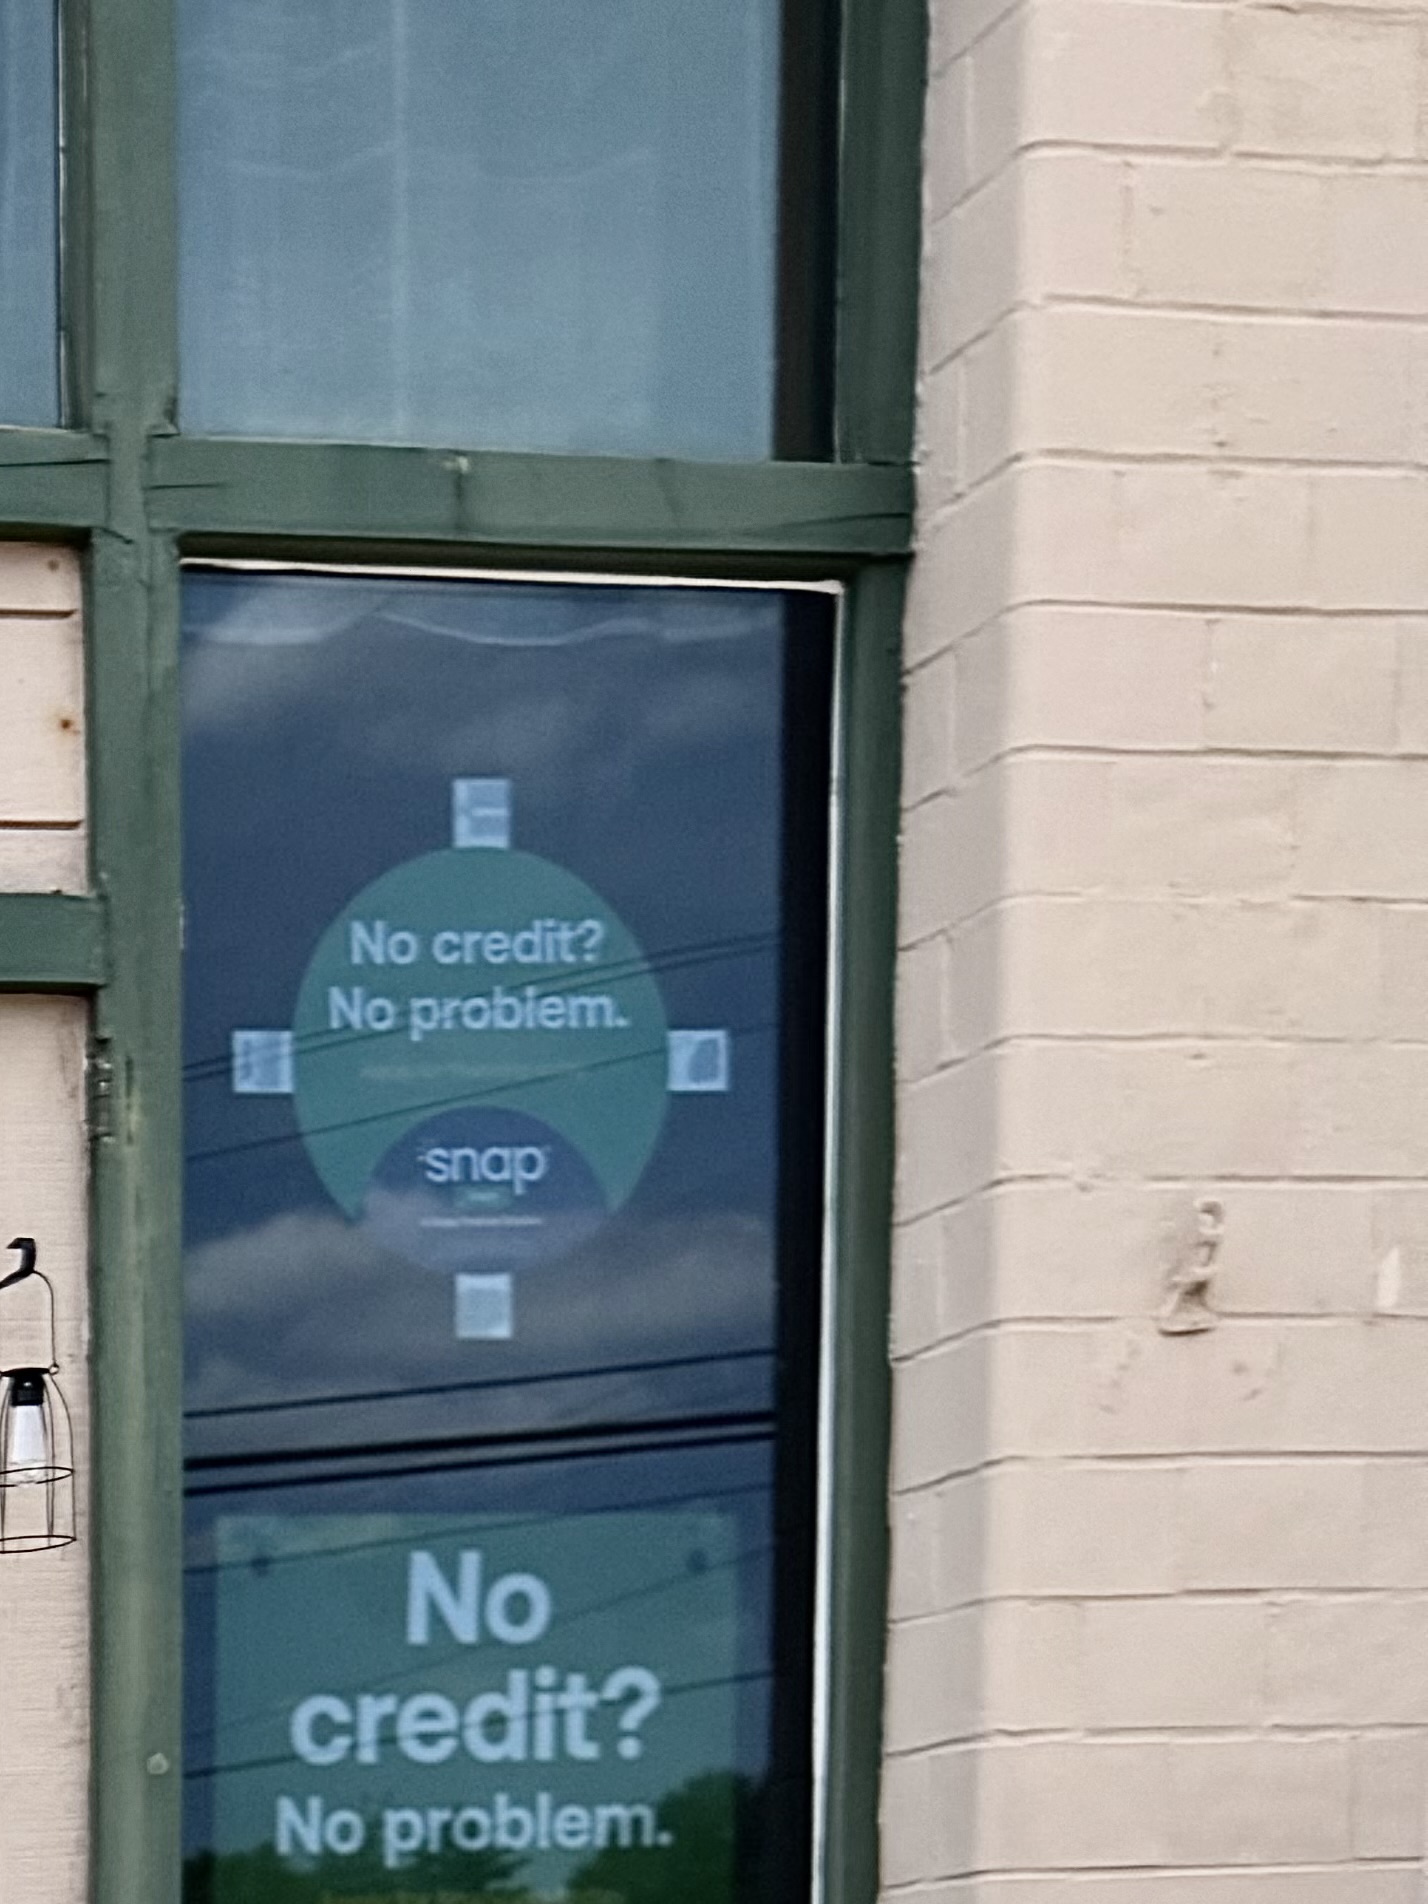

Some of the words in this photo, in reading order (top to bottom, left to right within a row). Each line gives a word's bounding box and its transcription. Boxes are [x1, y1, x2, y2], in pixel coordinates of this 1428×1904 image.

[351, 920, 417, 967] No
[433, 918, 604, 964] credit?
[328, 986, 395, 1032] No
[409, 986, 630, 1042] problem.
[425, 1146, 545, 1195] snap
[406, 1550, 551, 1646] No
[290, 1665, 662, 1765] credit?
[276, 1796, 364, 1857] No
[383, 1792, 673, 1869] problem.
